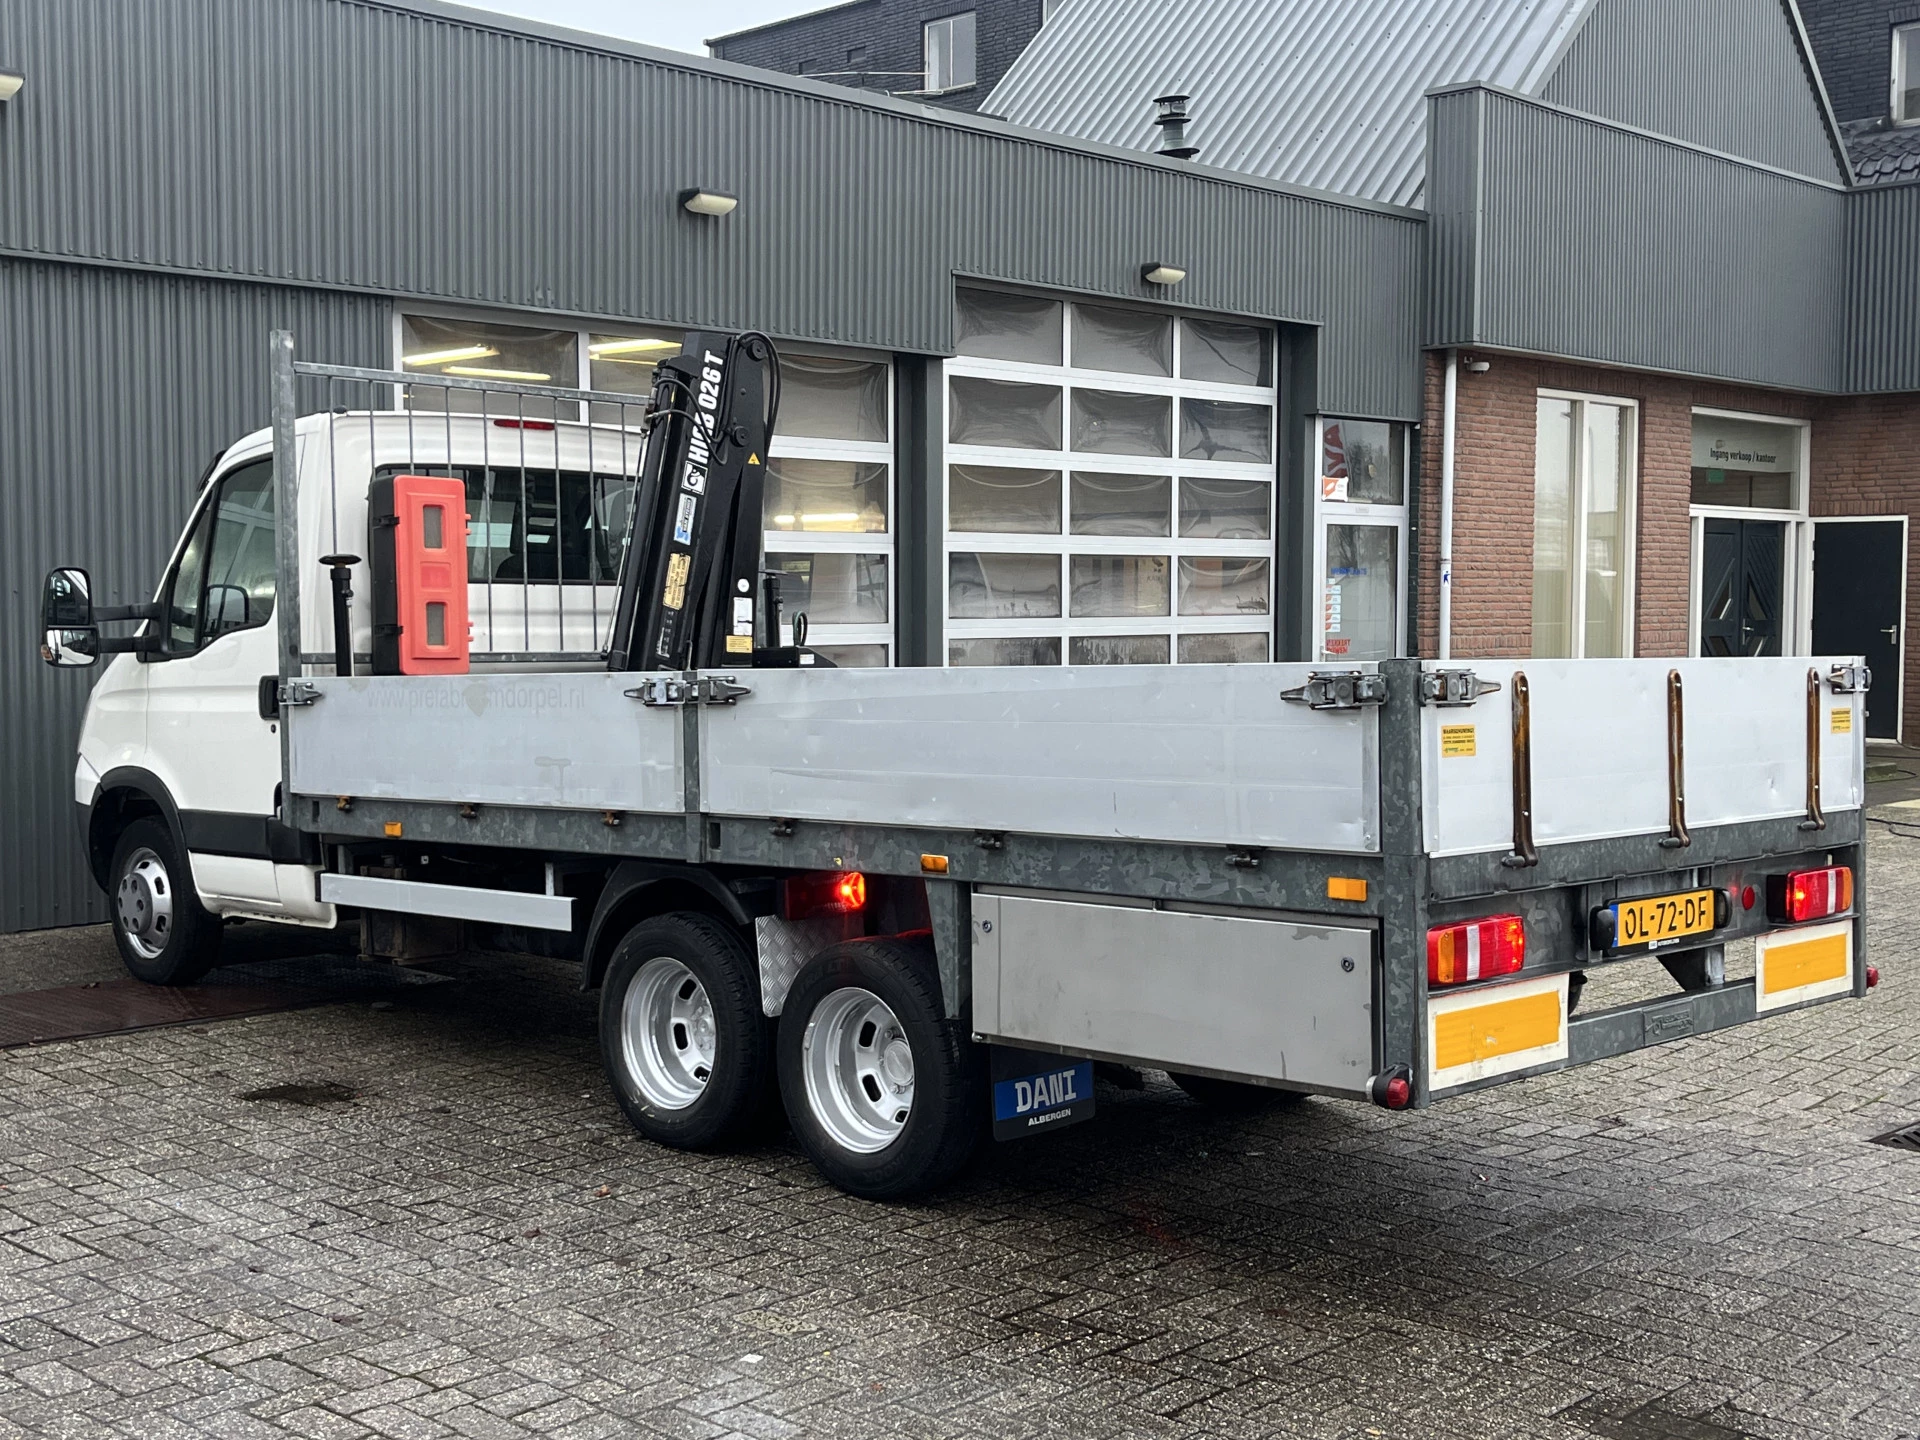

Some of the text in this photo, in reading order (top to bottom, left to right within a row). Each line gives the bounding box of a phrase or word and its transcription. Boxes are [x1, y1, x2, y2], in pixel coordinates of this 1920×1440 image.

[704, 349, 724, 366] T
[698, 366, 722, 410] 026
[1710, 448, 1729, 460] Ingang
[1730, 450, 1751, 463] verkoop
[1756, 452, 1776, 463] kantoor
[1625, 896, 1707, 939] OL-72-DF
[1014, 1069, 1077, 1113] DANI
[1028, 1108, 1071, 1127] ALBERGEN
